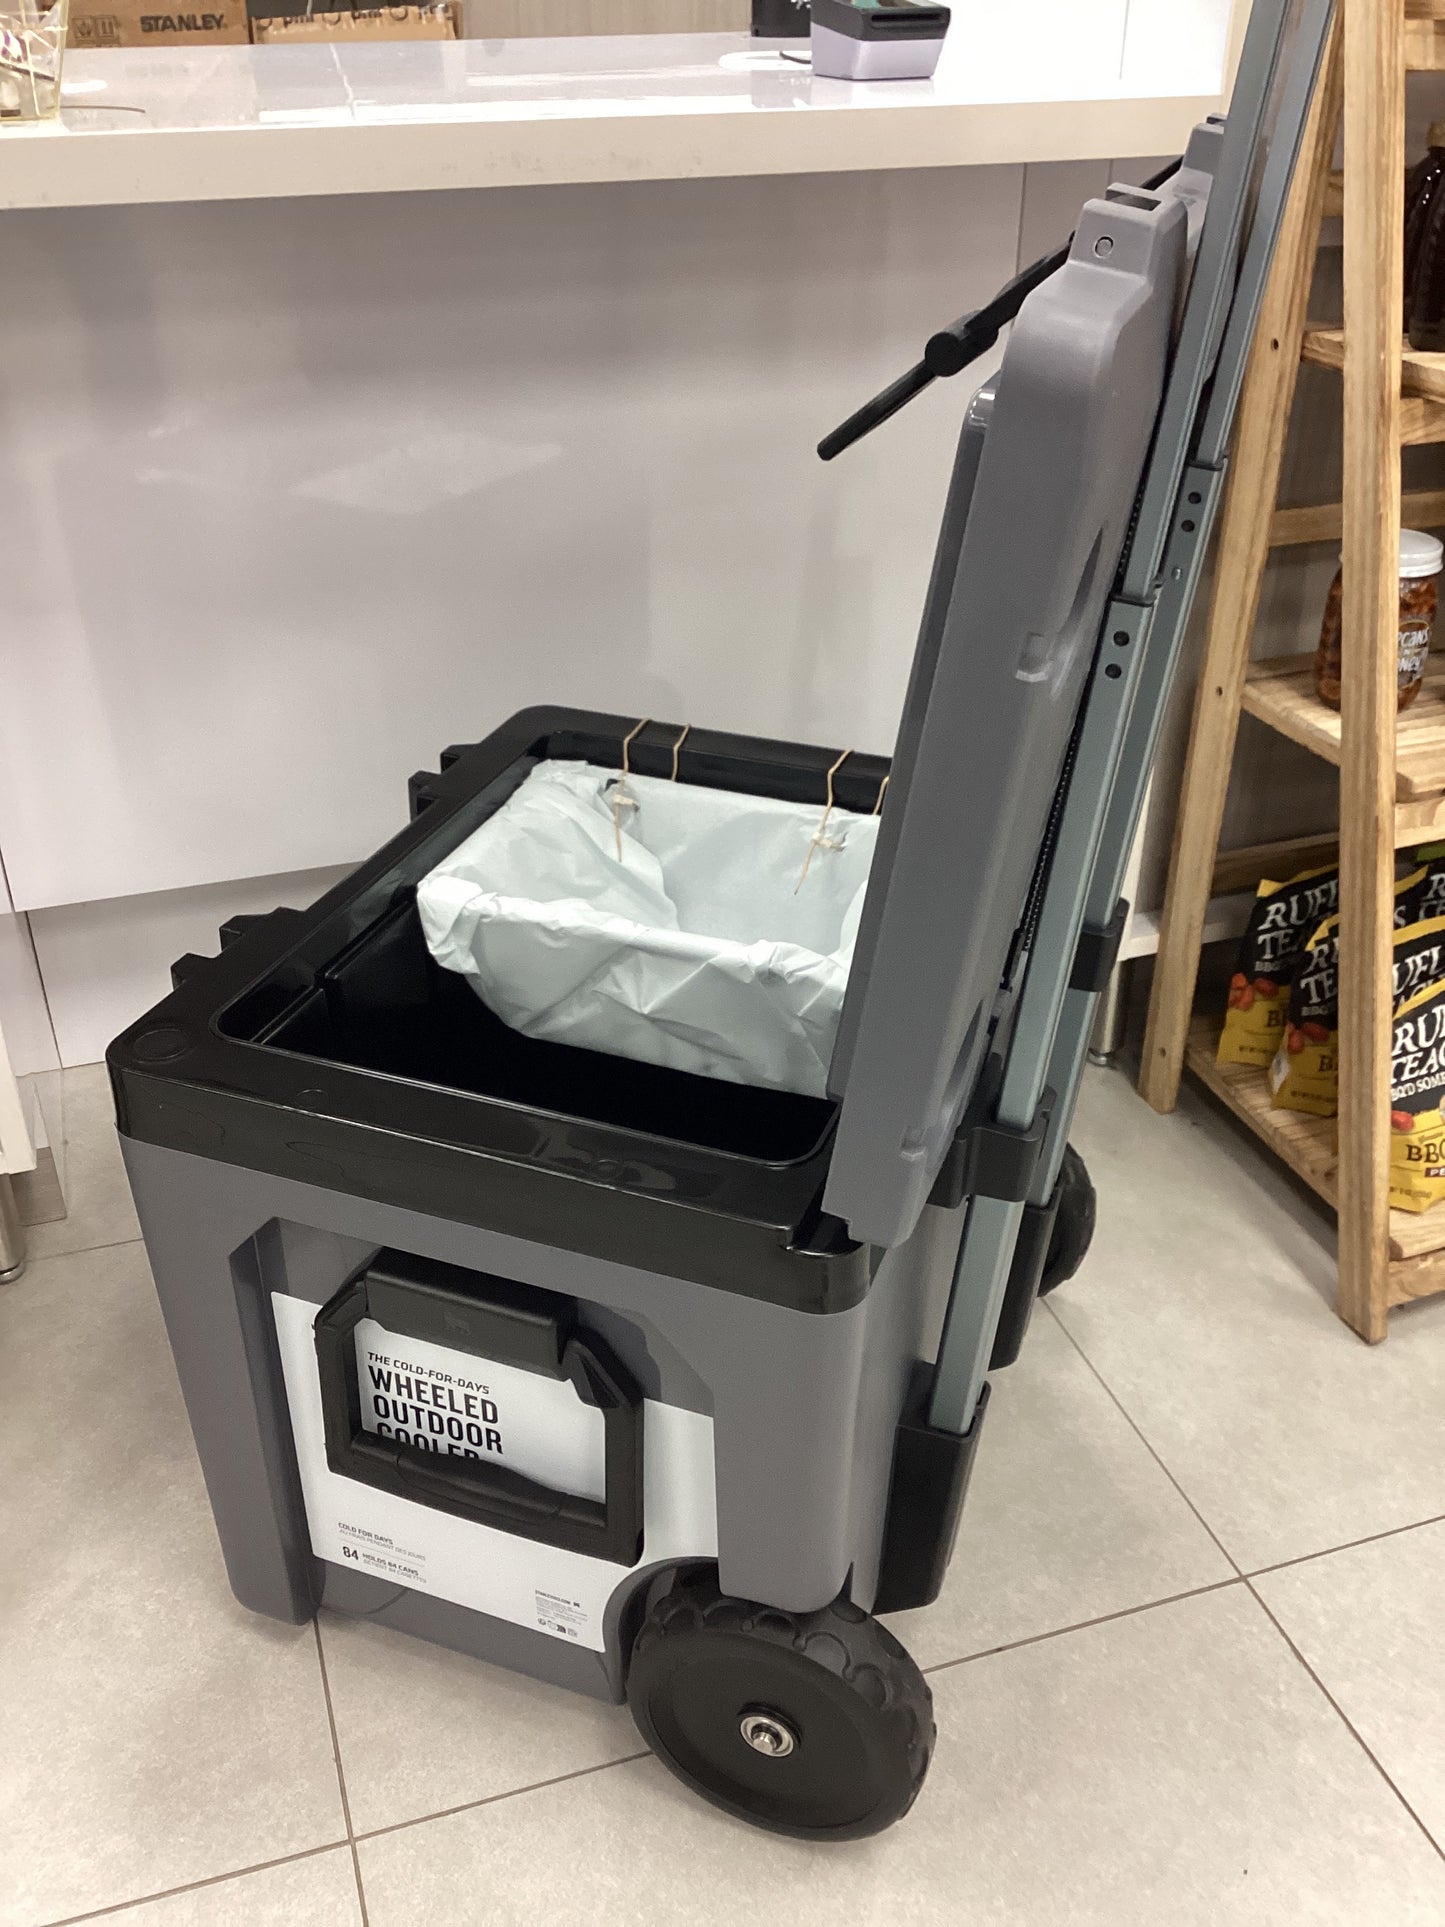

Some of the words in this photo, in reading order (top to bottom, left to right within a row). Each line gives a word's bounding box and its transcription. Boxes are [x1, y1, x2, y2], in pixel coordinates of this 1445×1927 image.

[140, 13, 225, 33] STANLEY
[368, 1352, 391, 1366] THE
[393, 1359, 490, 1395] COLD-FOR-DAYS
[367, 1365, 499, 1424] WHEELED
[373, 1394, 504, 1455] OUTDOOR
[338, 1522, 357, 1533] COLD
[358, 1528, 373, 1538] FOR
[374, 1534, 394, 1545] DAYS
[342, 1546, 359, 1561] 84
